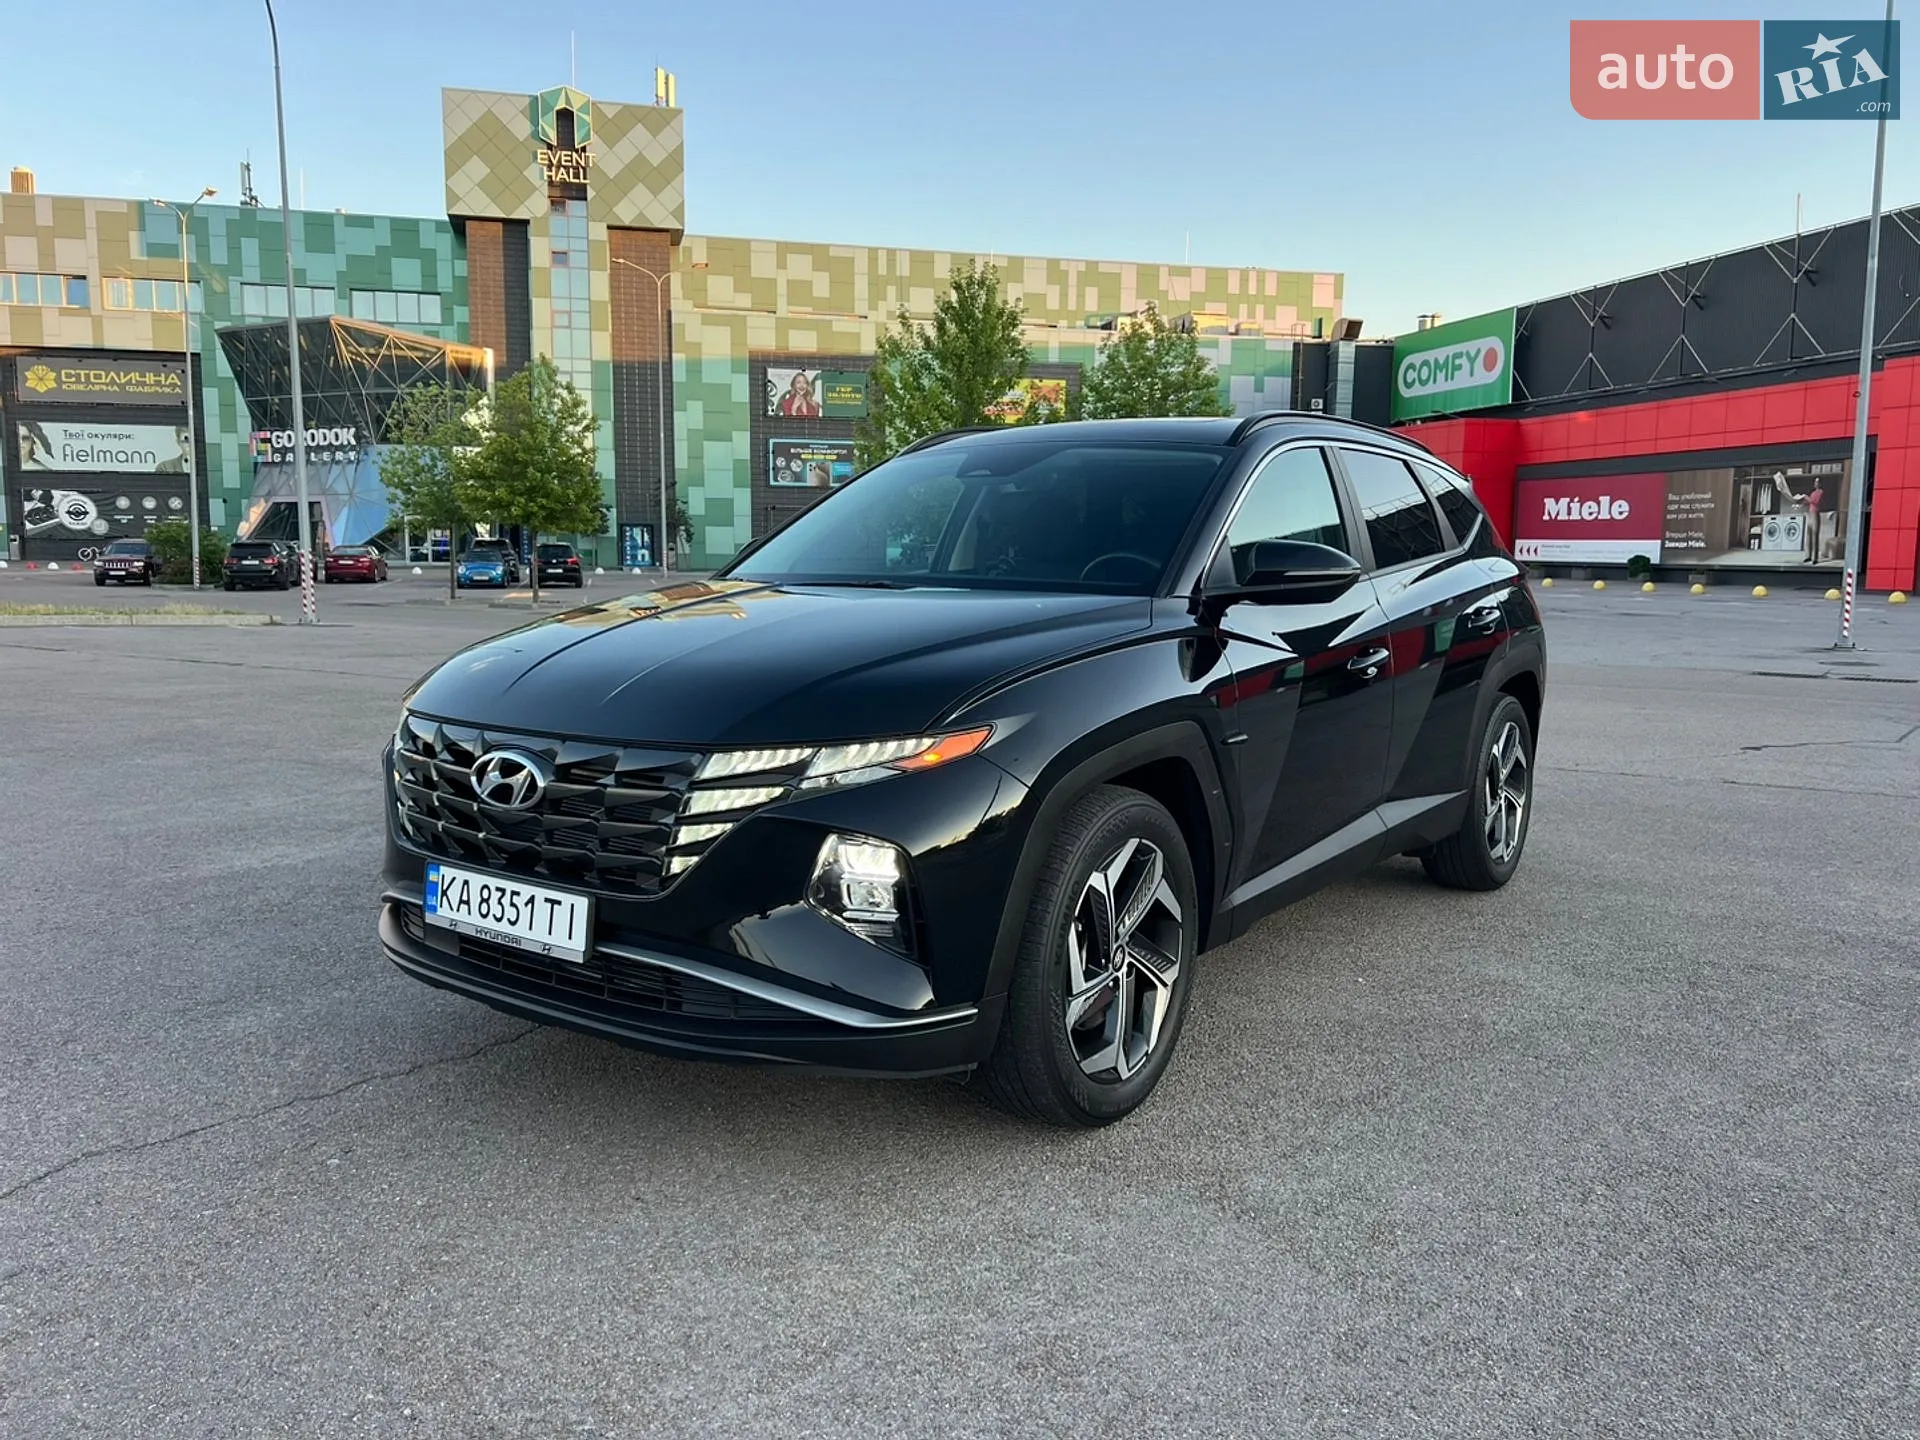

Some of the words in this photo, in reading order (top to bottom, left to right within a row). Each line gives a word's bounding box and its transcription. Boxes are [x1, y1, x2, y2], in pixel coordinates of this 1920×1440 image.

[537, 149, 597, 167] EVENT
[543, 166, 591, 183] HALL
[61, 369, 182, 385] СТОЛИЧНА
[1403, 347, 1481, 390] COMFY
[62, 443, 156, 464] fielmann
[273, 451, 357, 462] GALERY
[1542, 496, 1630, 521] Miele
[474, 927, 522, 946] HYUNDAI
